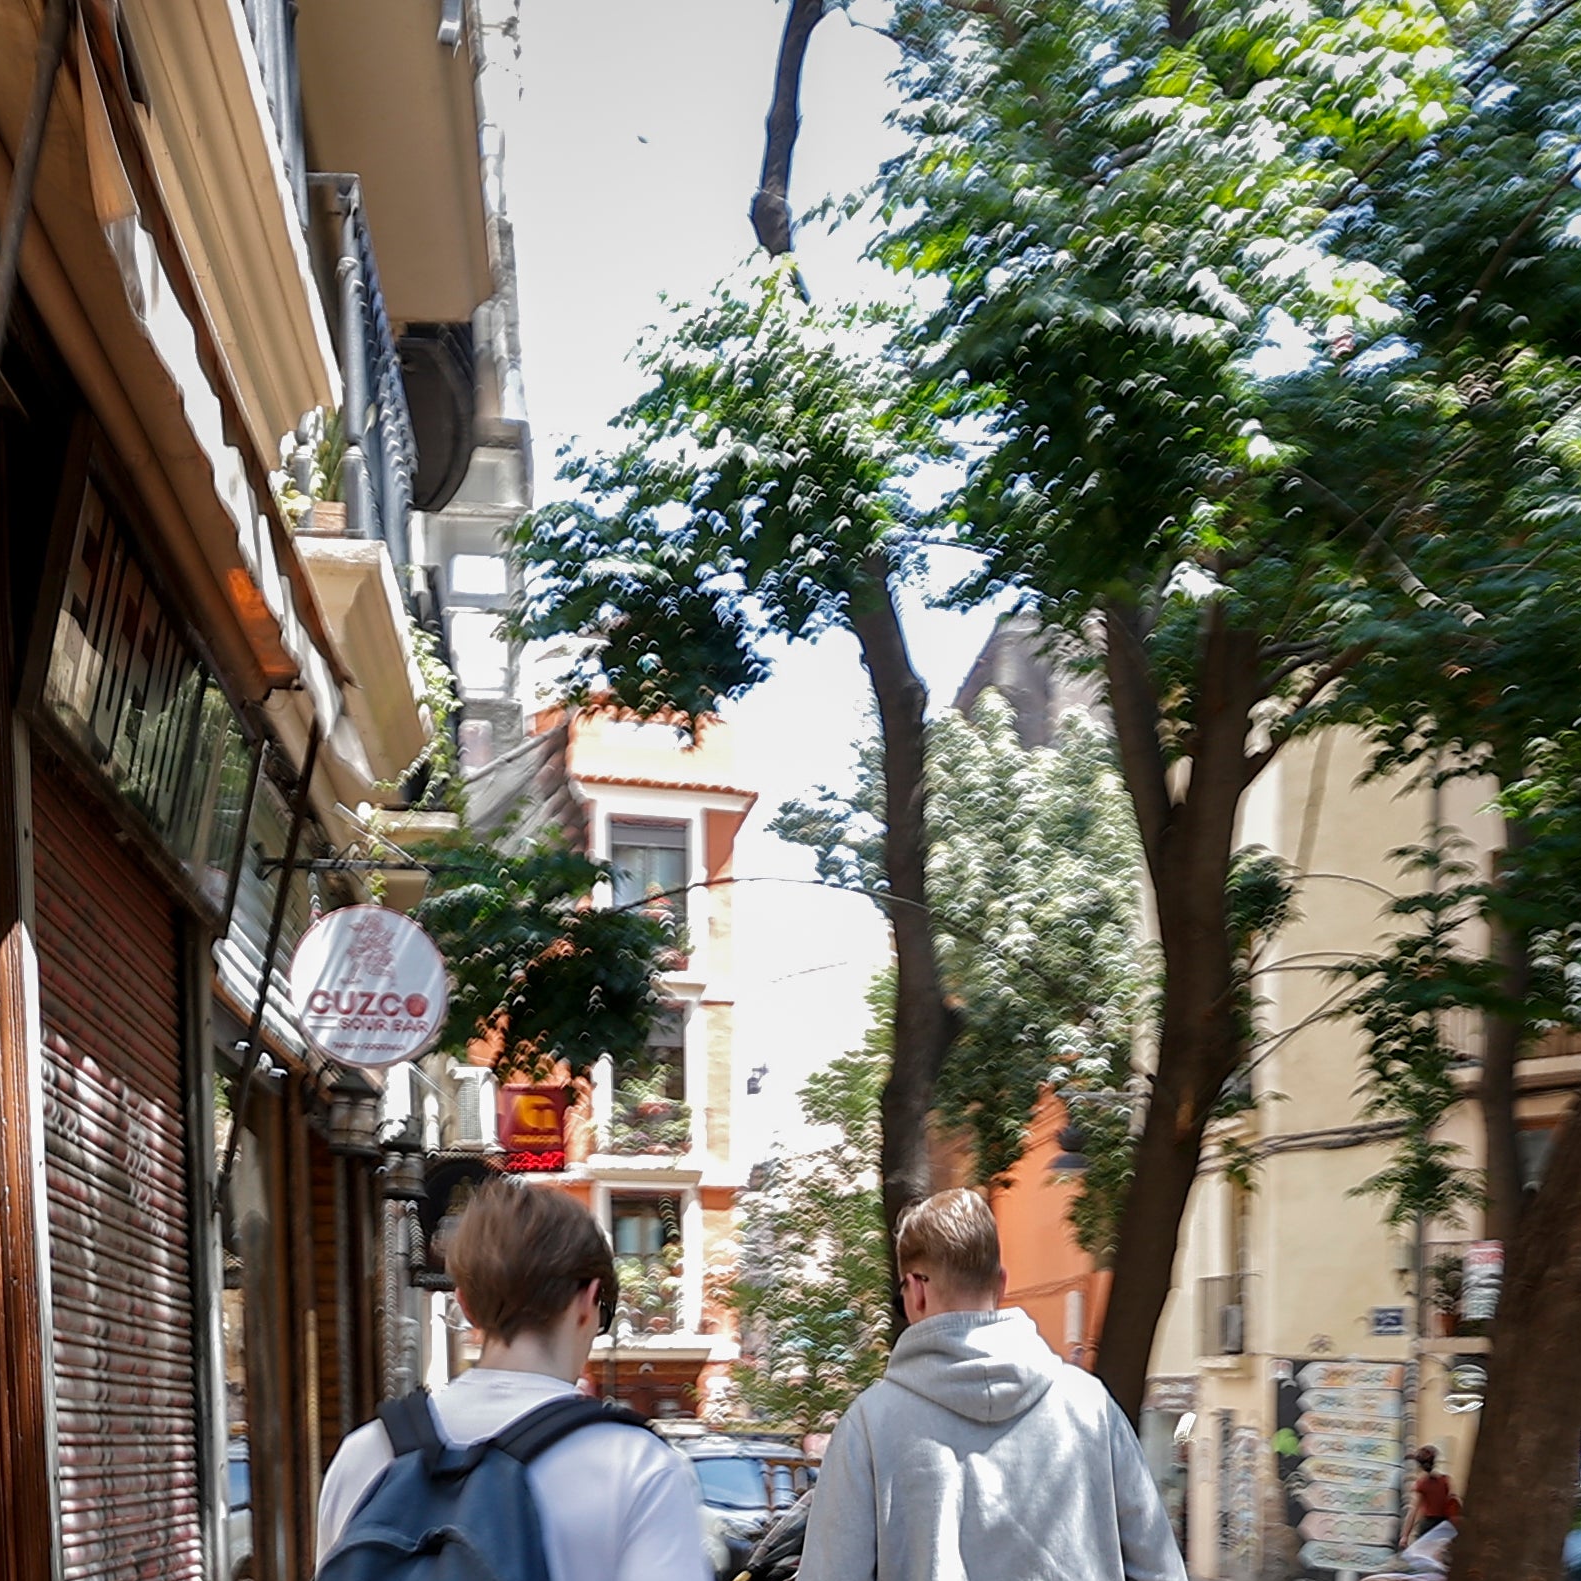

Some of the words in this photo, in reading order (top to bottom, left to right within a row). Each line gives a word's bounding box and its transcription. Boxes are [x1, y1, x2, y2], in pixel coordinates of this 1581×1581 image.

[309, 990, 428, 1017] CUZCO
[339, 1018, 388, 1031] SOUR
[393, 1020, 428, 1032] BAR
